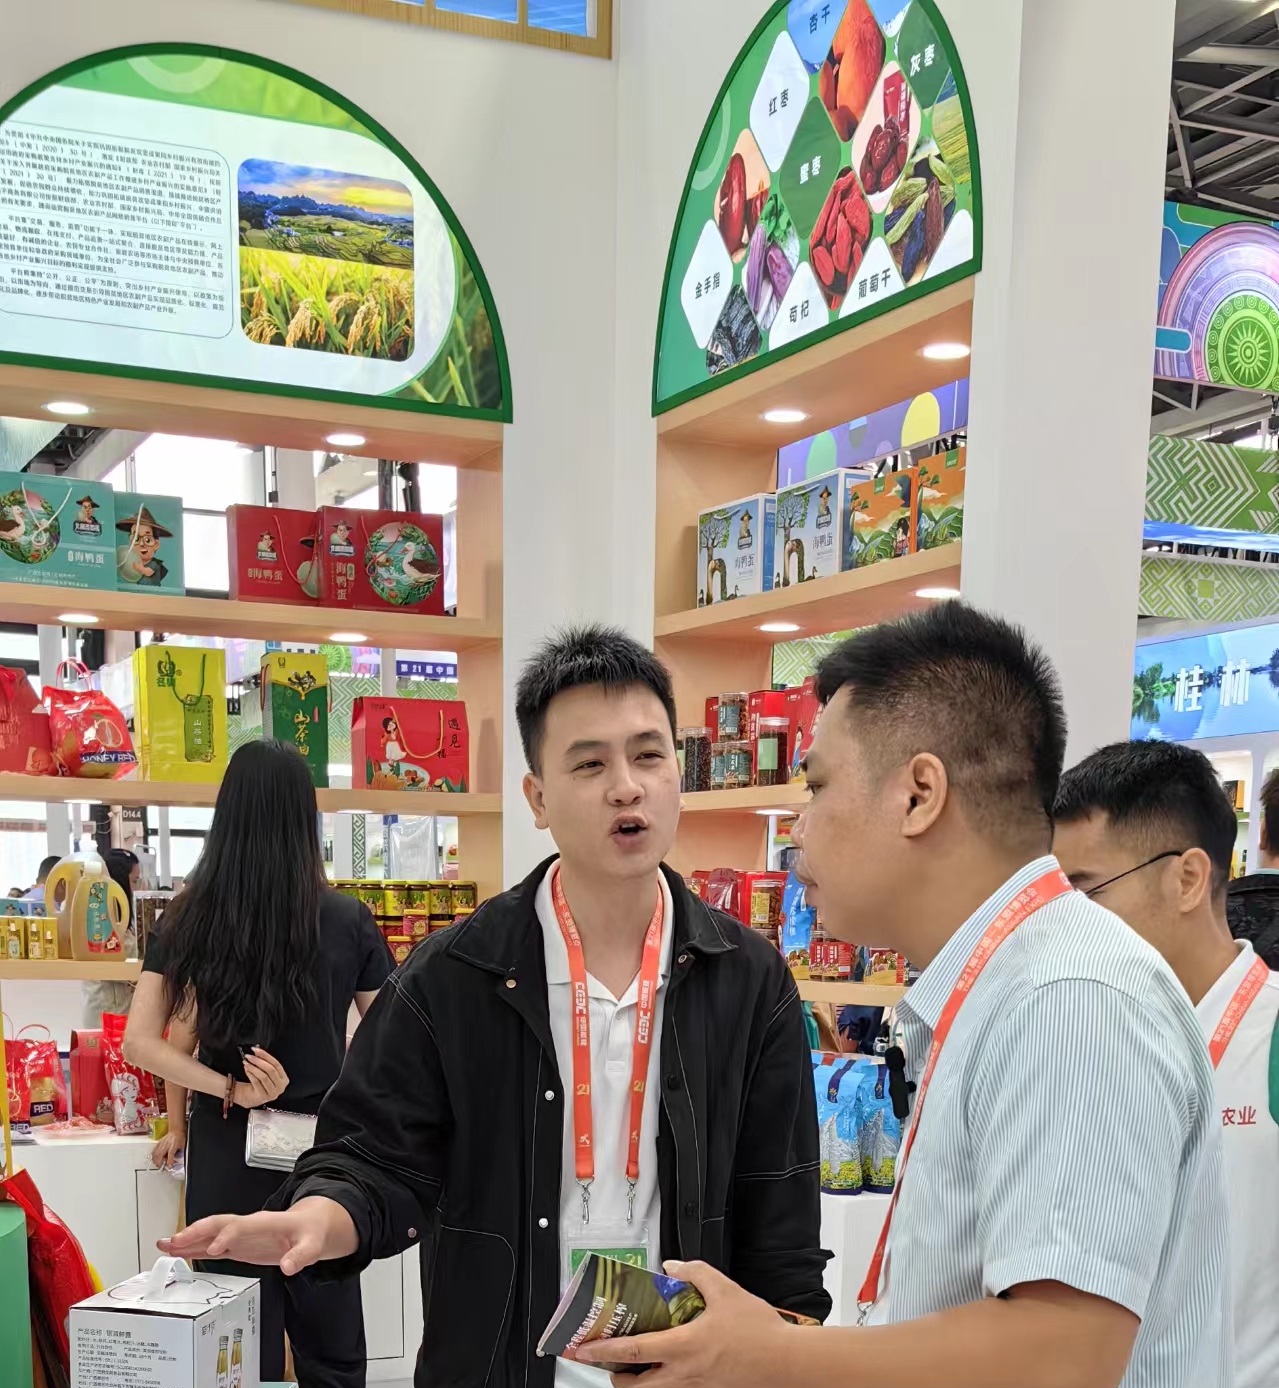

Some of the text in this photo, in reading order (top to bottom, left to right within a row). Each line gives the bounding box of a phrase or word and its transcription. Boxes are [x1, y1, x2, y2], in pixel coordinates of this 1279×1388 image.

[809, 4, 831, 35] 杏干
[909, 43, 935, 77] 灰枣
[768, 88, 789, 117] 红枣
[799, 155, 821, 185] 蜜枣
[695, 271, 721, 299] 金手指
[858, 268, 891, 300] 葡萄干
[1173, 658, 1251, 713] 桂林
[294, 708, 310, 756] 山茶油
[122, 809, 142, 819] D14.4
[33, 1103, 53, 1113] RED
[1222, 1105, 1257, 1126] 农业
[77, 1327, 103, 1337] 产品名称
